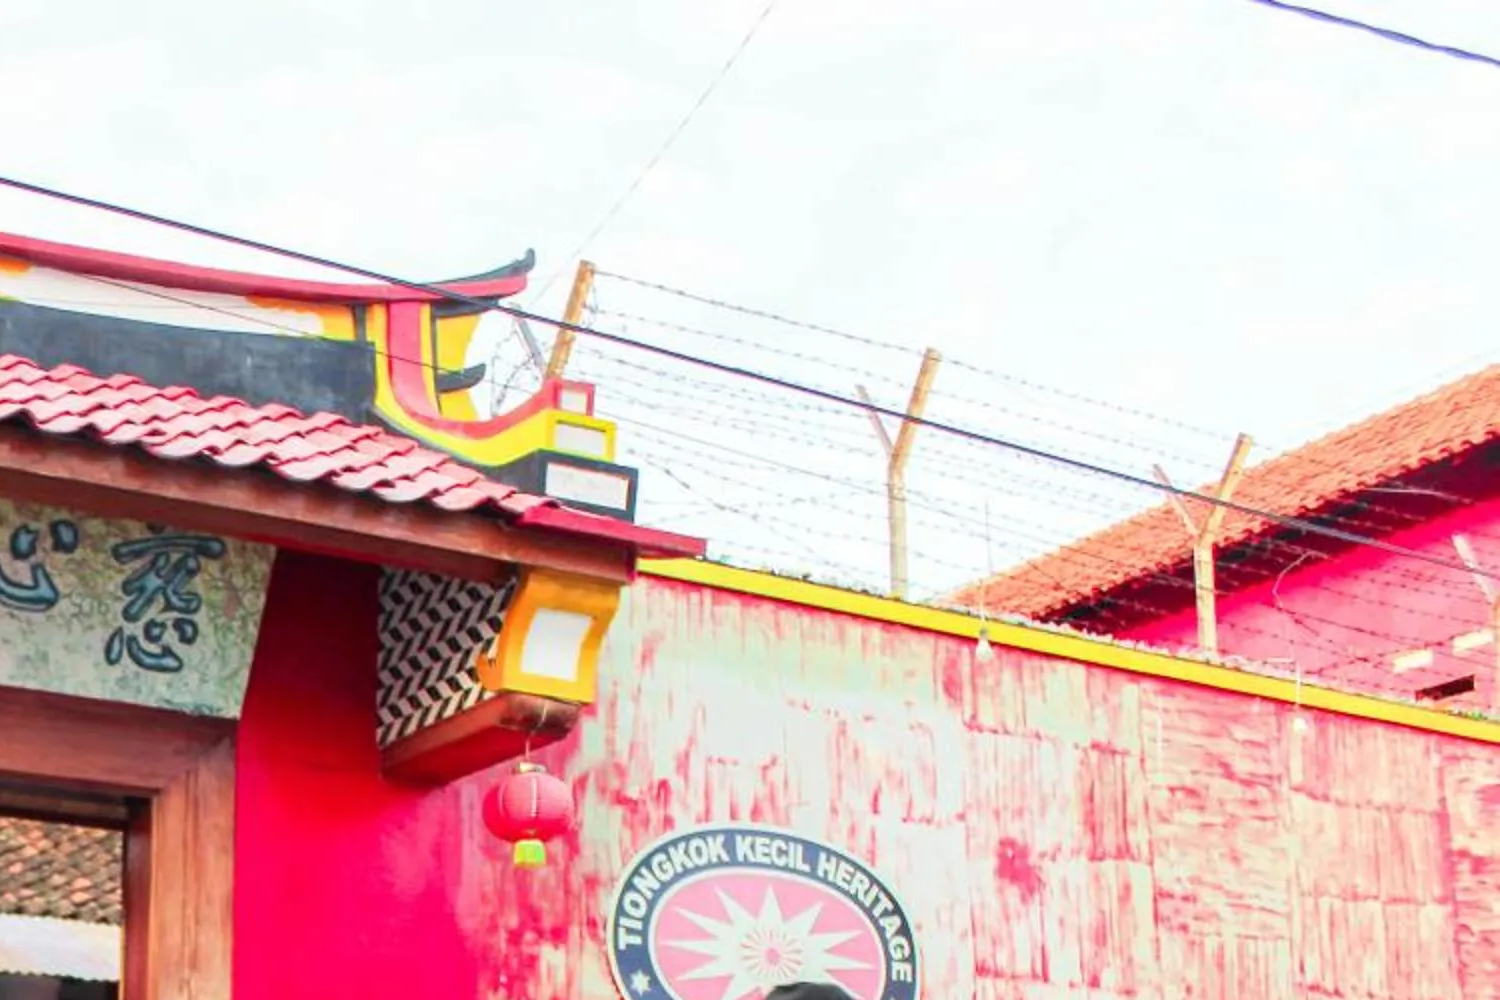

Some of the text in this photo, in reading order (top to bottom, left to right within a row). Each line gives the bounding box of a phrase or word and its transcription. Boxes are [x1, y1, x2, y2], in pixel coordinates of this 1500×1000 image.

[618, 834, 912, 983] TIONGKOK KECIL HERITAGE
